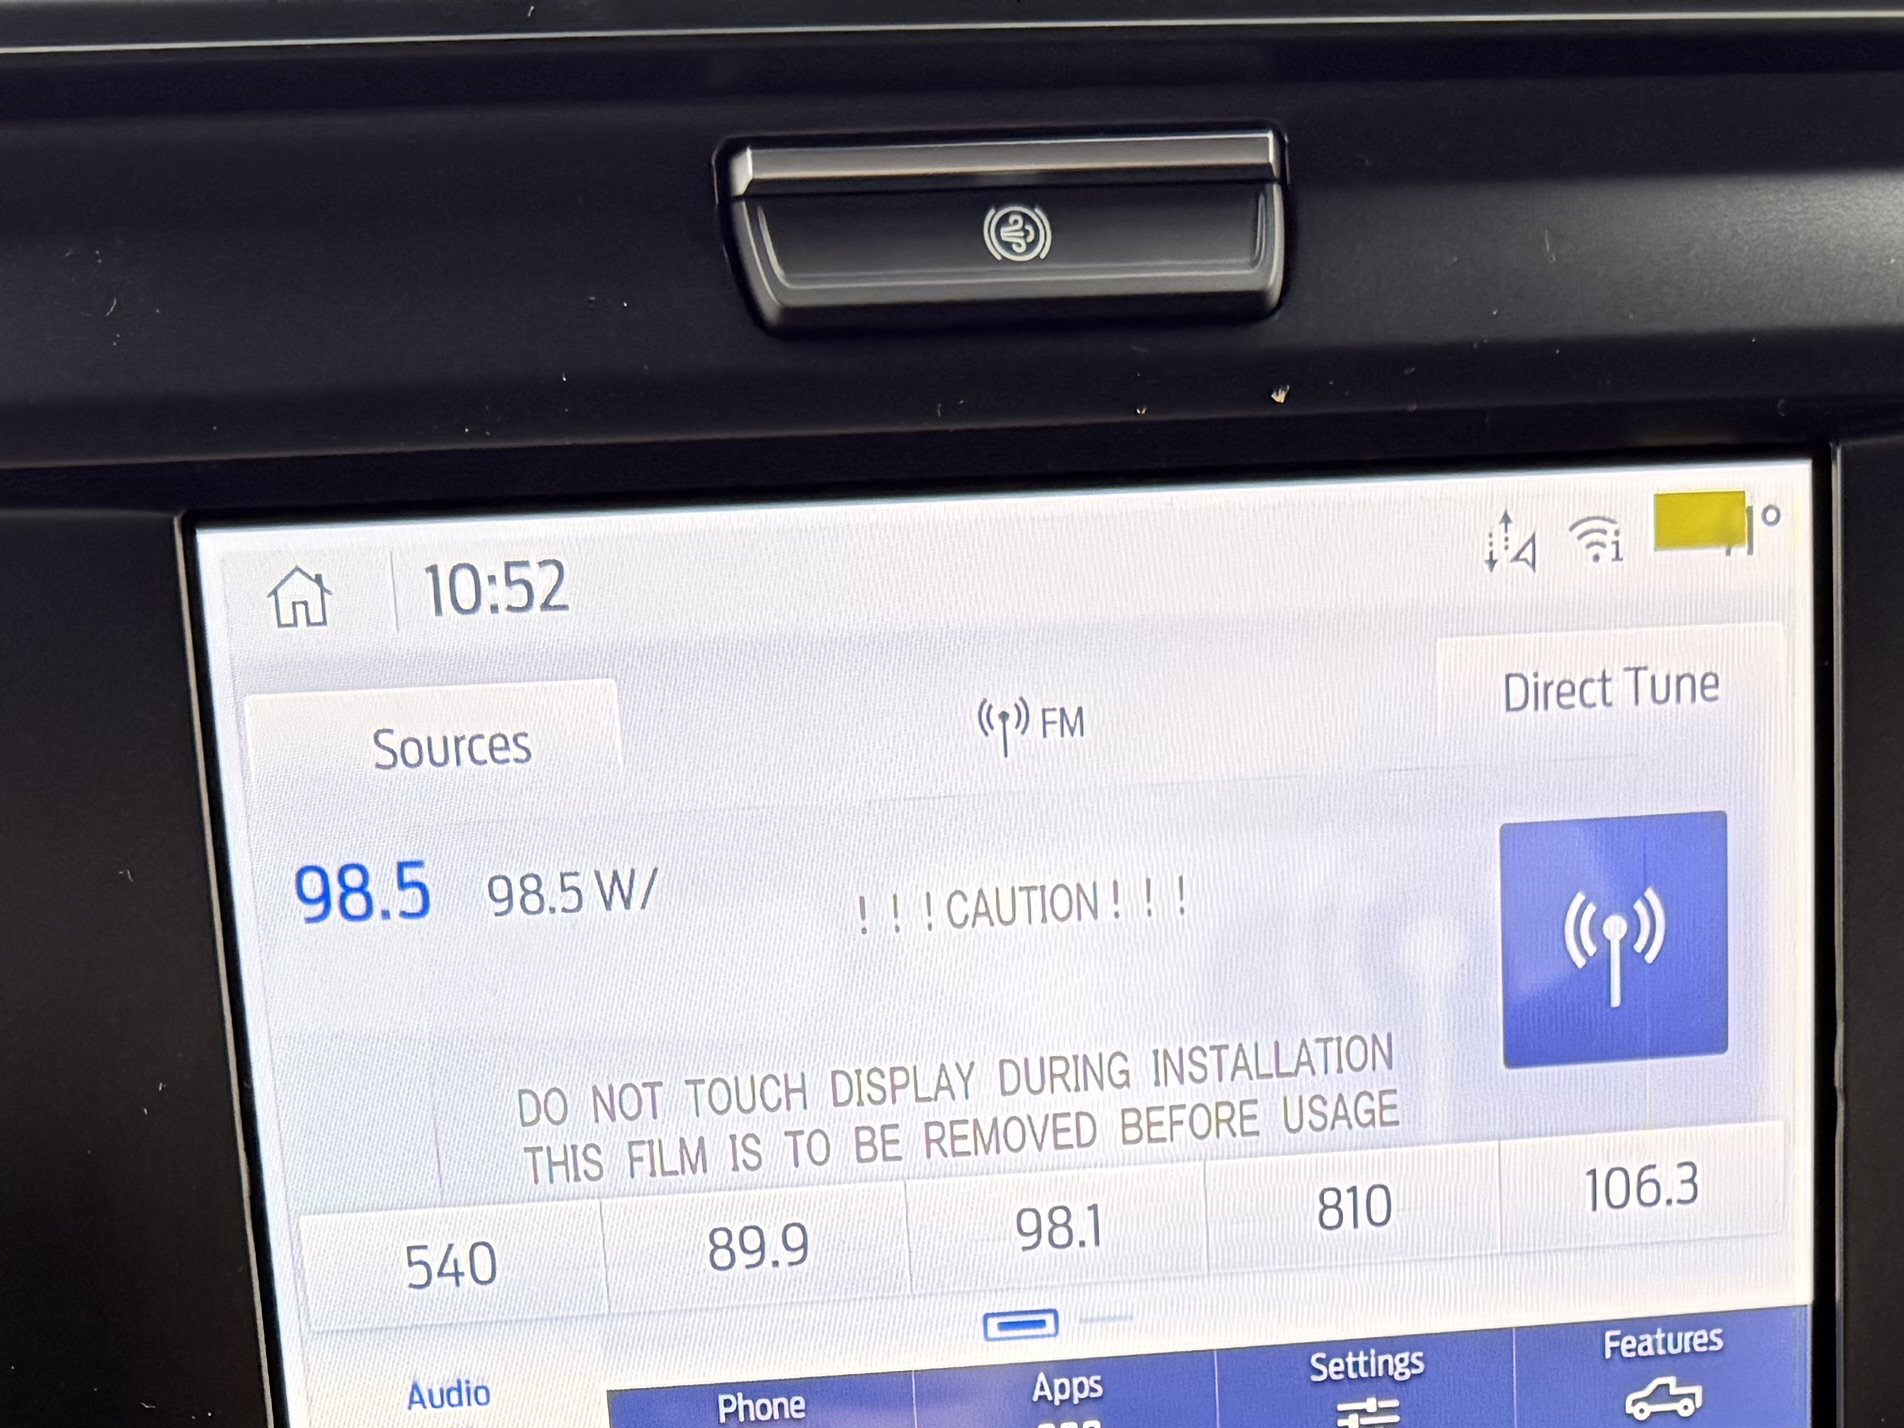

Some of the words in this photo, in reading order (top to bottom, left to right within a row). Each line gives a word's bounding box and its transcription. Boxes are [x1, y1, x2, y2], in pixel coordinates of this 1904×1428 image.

[425, 558, 569, 617] 10:52
[1504, 669, 1613, 713] Direct
[1623, 665, 1720, 706] Tune
[1041, 705, 1085, 739] FM
[372, 727, 532, 771] Sources
[295, 860, 431, 924] 98.5
[487, 870, 584, 918] 98.5
[517, 1086, 569, 1128] DO
[591, 1080, 664, 1124] NOT
[684, 1071, 808, 1118] TOUCH
[830, 1060, 976, 1108] DISPLAY
[998, 1049, 1131, 1097] DURING
[1152, 1030, 1397, 1093] INSTALLATION
[523, 1142, 604, 1186] THIS
[627, 1135, 708, 1180] FILM
[728, 1132, 763, 1173] IS
[783, 1128, 831, 1169] TO
[854, 1122, 903, 1164] BE
[923, 1110, 1098, 1160] REMOVED
[1120, 1098, 1261, 1146] BEFORE
[1282, 1088, 1401, 1135] USAGE
[1318, 1183, 1393, 1231] 810
[1586, 1160, 1699, 1212] 106.3
[708, 1221, 809, 1272] 89.9
[1016, 1203, 1101, 1252] 98.1
[406, 1240, 497, 1291] 540
[1309, 1347, 1426, 1382] Settings
[1604, 1326, 1725, 1359] Features
[407, 1378, 491, 1410] Audio
[717, 1391, 807, 1425] Phone
[1031, 1369, 1104, 1407] Apps
